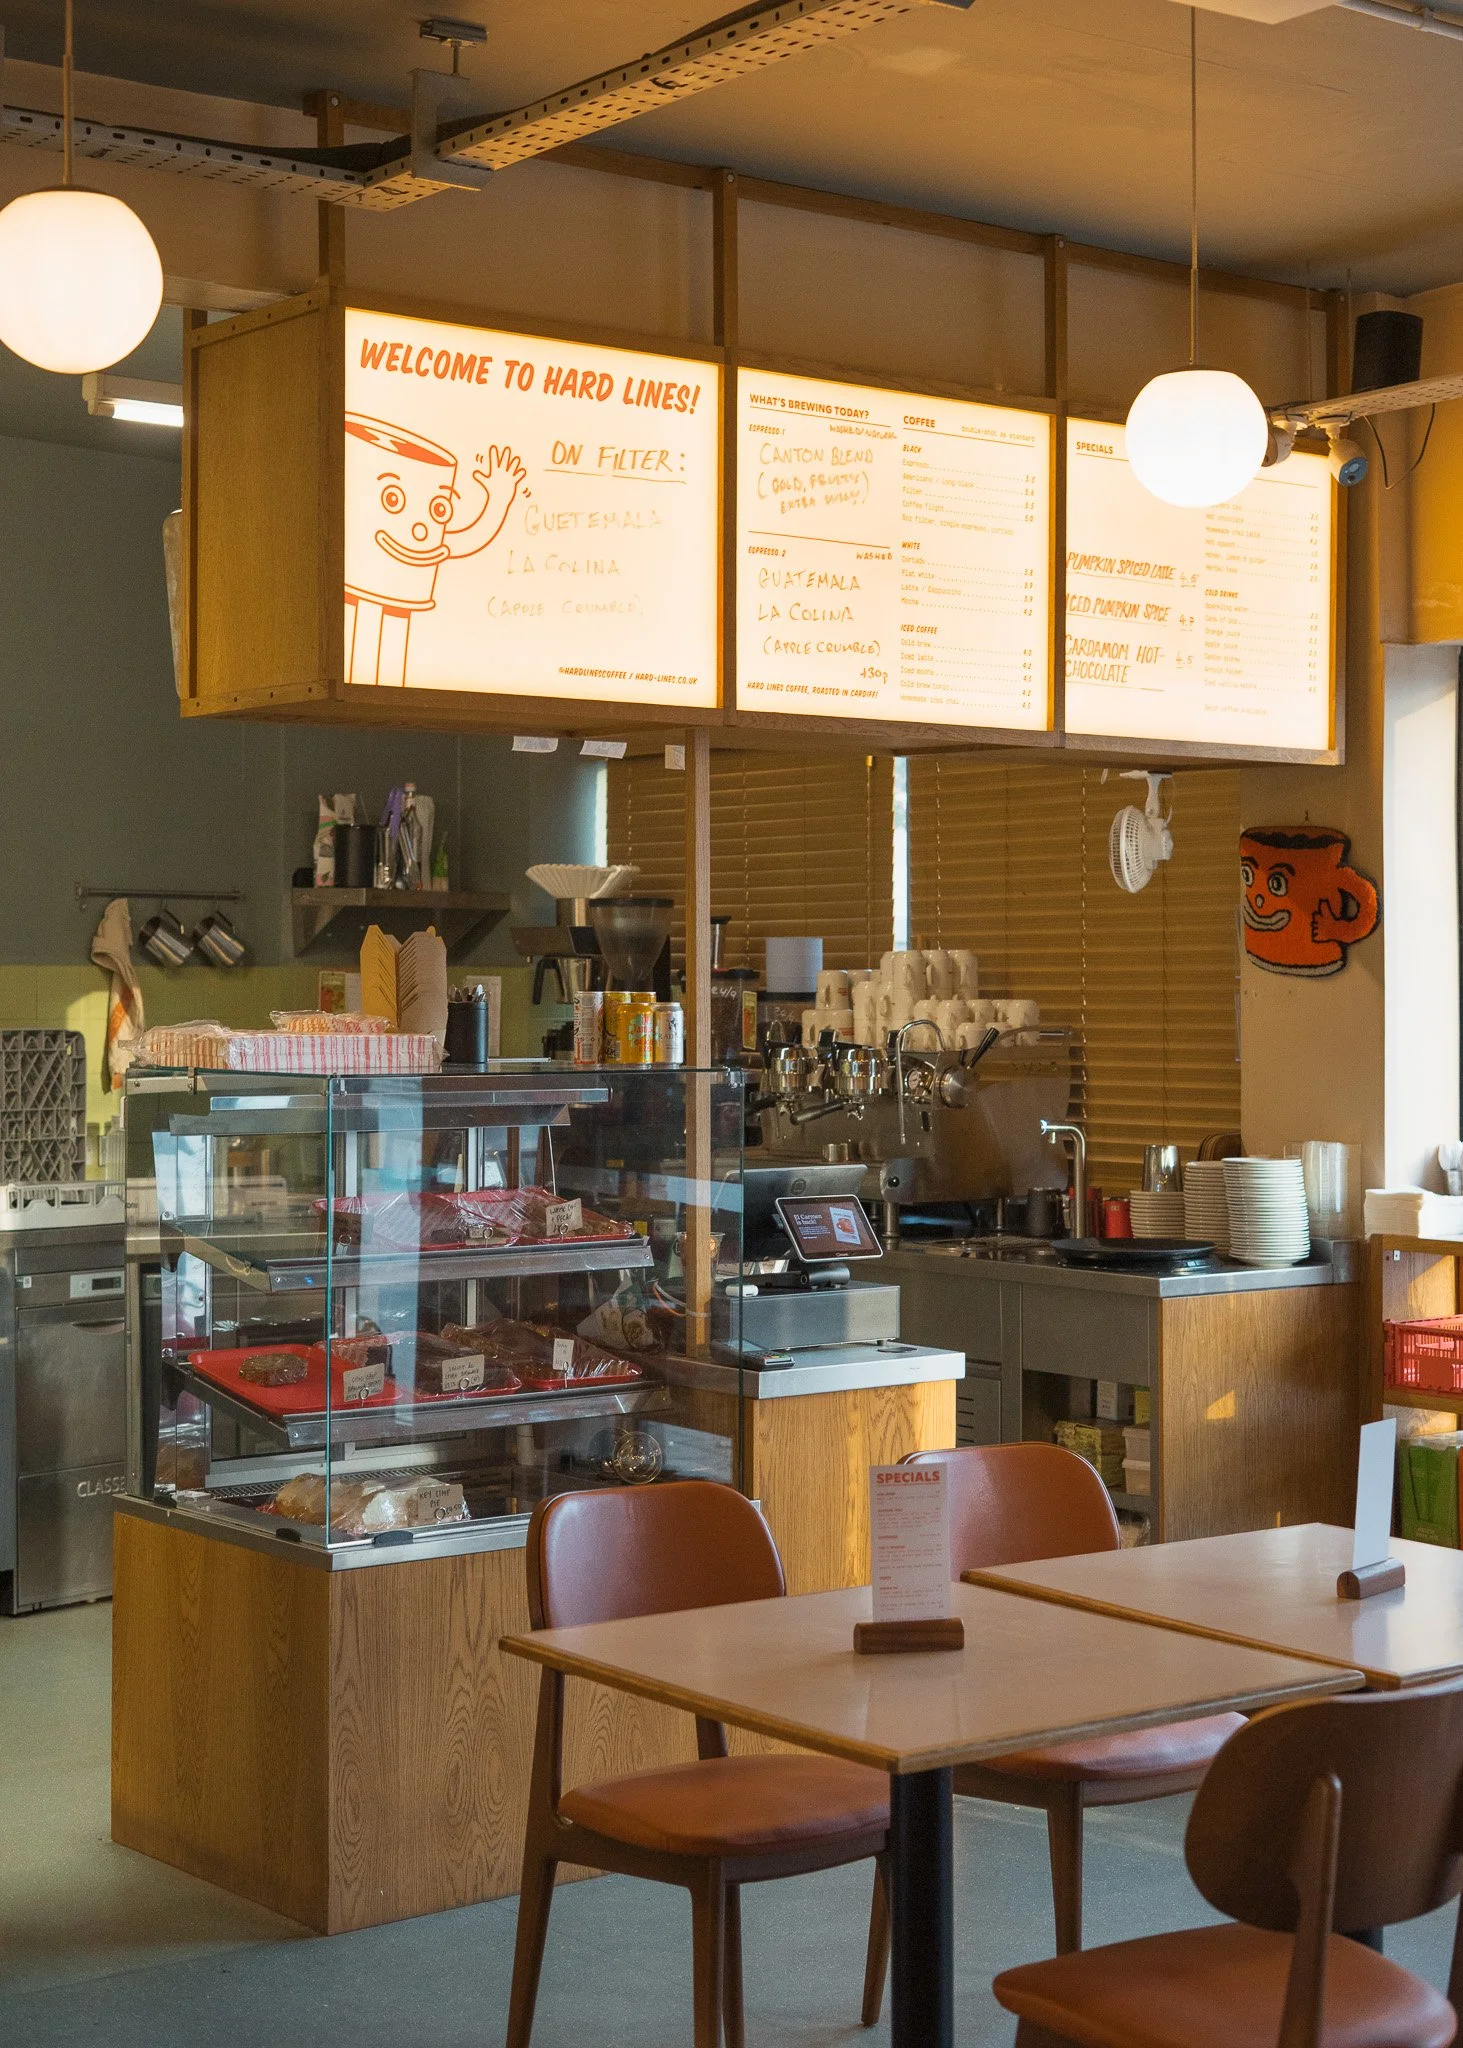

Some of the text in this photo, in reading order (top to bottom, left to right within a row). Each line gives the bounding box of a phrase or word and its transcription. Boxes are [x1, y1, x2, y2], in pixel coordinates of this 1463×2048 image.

[360, 338, 701, 415] WELCOME TO HARD LINES!
[750, 394, 869, 419] WHAT'S BREWING TODAY?
[903, 415, 936, 428] COFFEE
[748, 424, 779, 435] ESPRESSO
[760, 442, 874, 466] CANTON BLEND
[902, 444, 922, 453] BLACK
[1076, 441, 1113, 455] SPECIALS
[551, 440, 686, 473] ON FILTER:
[524, 504, 663, 536] GUETEMALA
[748, 546, 779, 557] ESPRESSO
[901, 541, 921, 550] WHITE
[506, 548, 621, 577] LA COLINA
[856, 552, 893, 561] WASHED
[1066, 551, 1114, 575] PUMPKIN
[1117, 558, 1150, 578] SPICED
[1150, 564, 1176, 581] LATTE
[758, 567, 861, 591] GUATEMALA
[1204, 588, 1218, 597] COLD
[758, 602, 854, 622] LA COLINA
[1066, 593, 1091, 614] ICED
[1092, 598, 1140, 619] PUMPKIN
[1143, 603, 1170, 622] SPICE
[900, 623, 938, 635] ICED COFFEE
[763, 636, 881, 657] (APPLE CRUMBLE)
[1065, 633, 1129, 660] CARDAMOM
[900, 652, 915, 661] Iced
[558, 665, 627, 681] @HARDLINESCOFFEE
[634, 671, 698, 686] HARD-LINES.CO.UK
[900, 666, 915, 675] Iced
[1065, 659, 1131, 683] CHOCOLATE
[747, 682, 764, 690] HARD
[766, 683, 784, 692] LINES
[785, 685, 810, 694] COFFEE,
[812, 686, 840, 696] ROASTED
[842, 689, 849, 697] IN
[876, 1470, 940, 1484] SPECIALS
[420, 1490, 432, 1500] KEY
[430, 1500, 440, 1508] PIE
